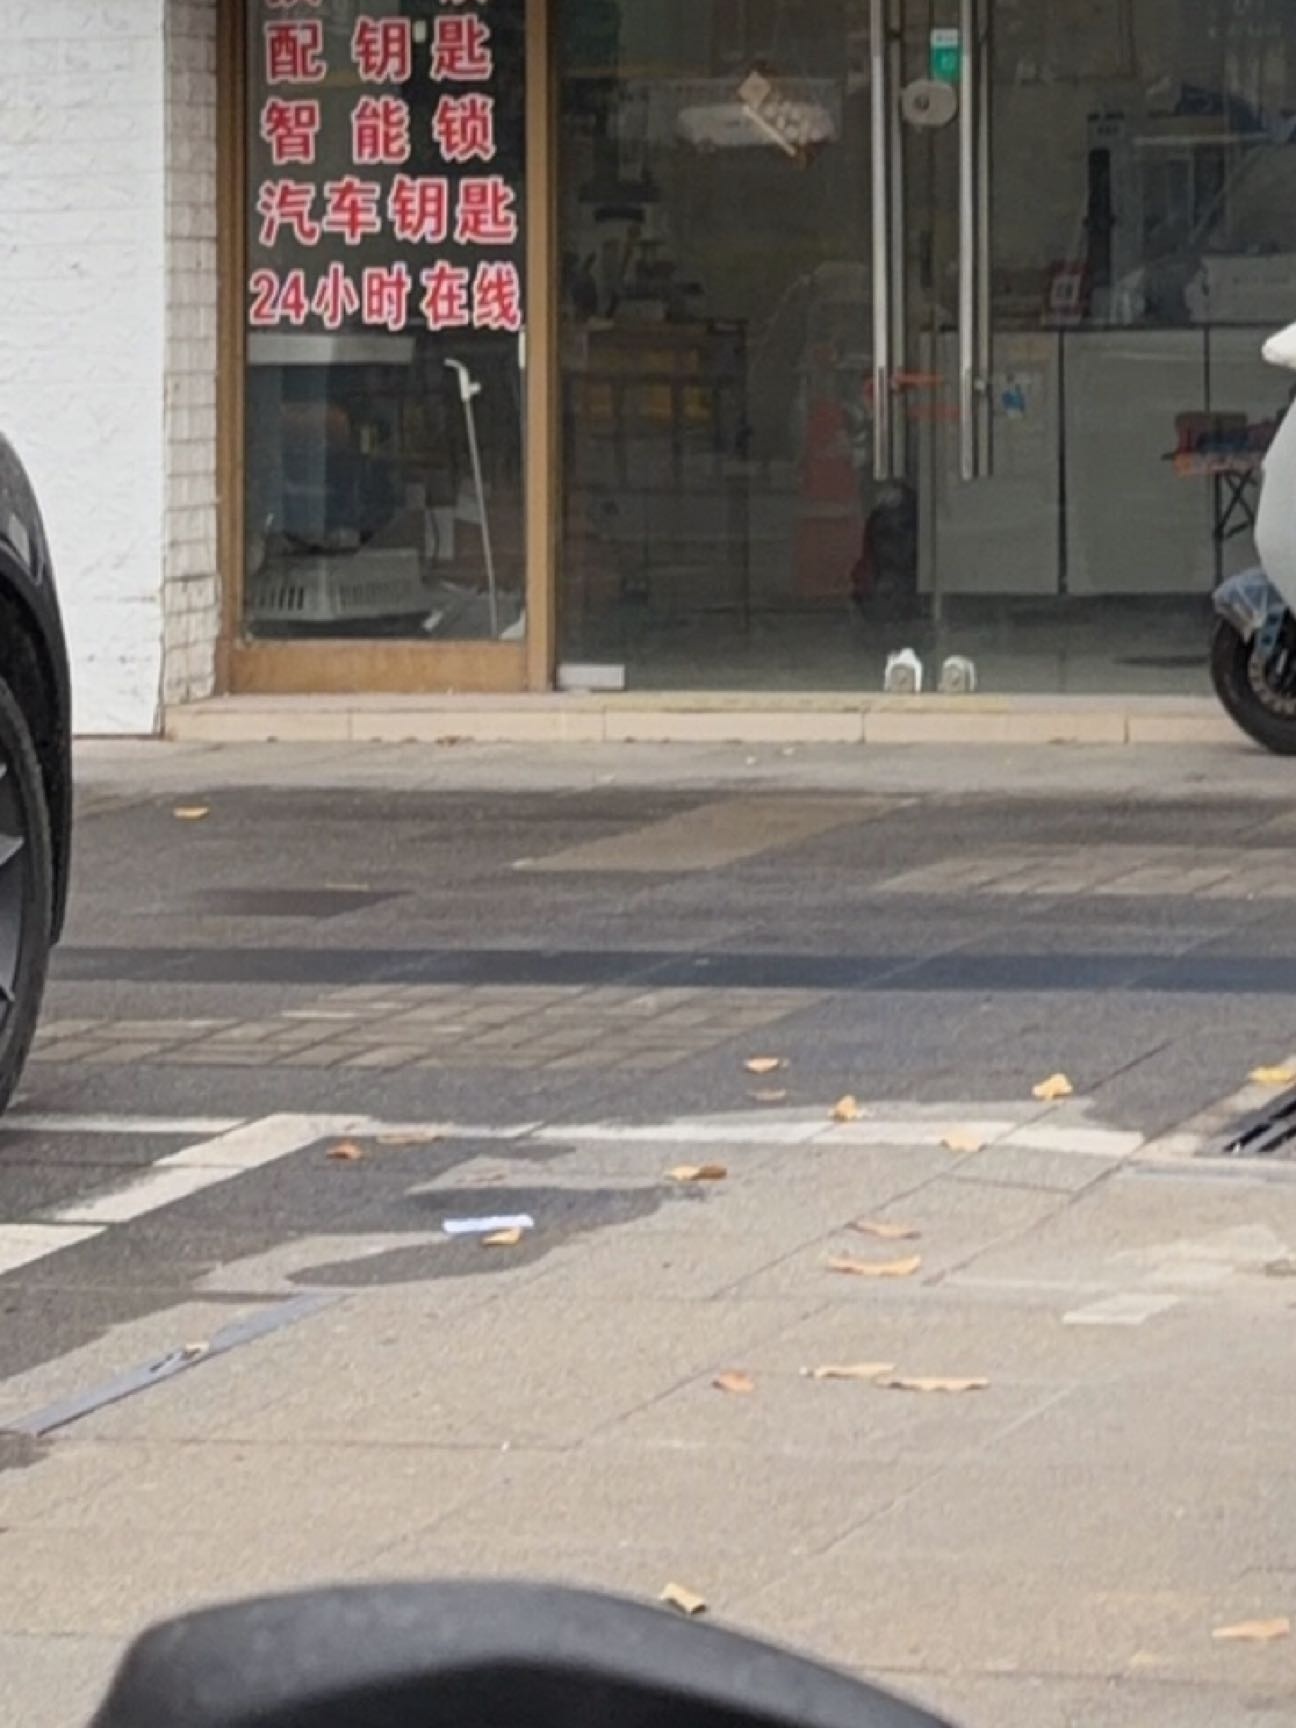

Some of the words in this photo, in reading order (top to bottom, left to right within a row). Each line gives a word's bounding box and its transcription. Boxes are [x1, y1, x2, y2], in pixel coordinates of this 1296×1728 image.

[258, 175, 519, 245] 汽车钥匙
[250, 261, 523, 331] 24小时在线
